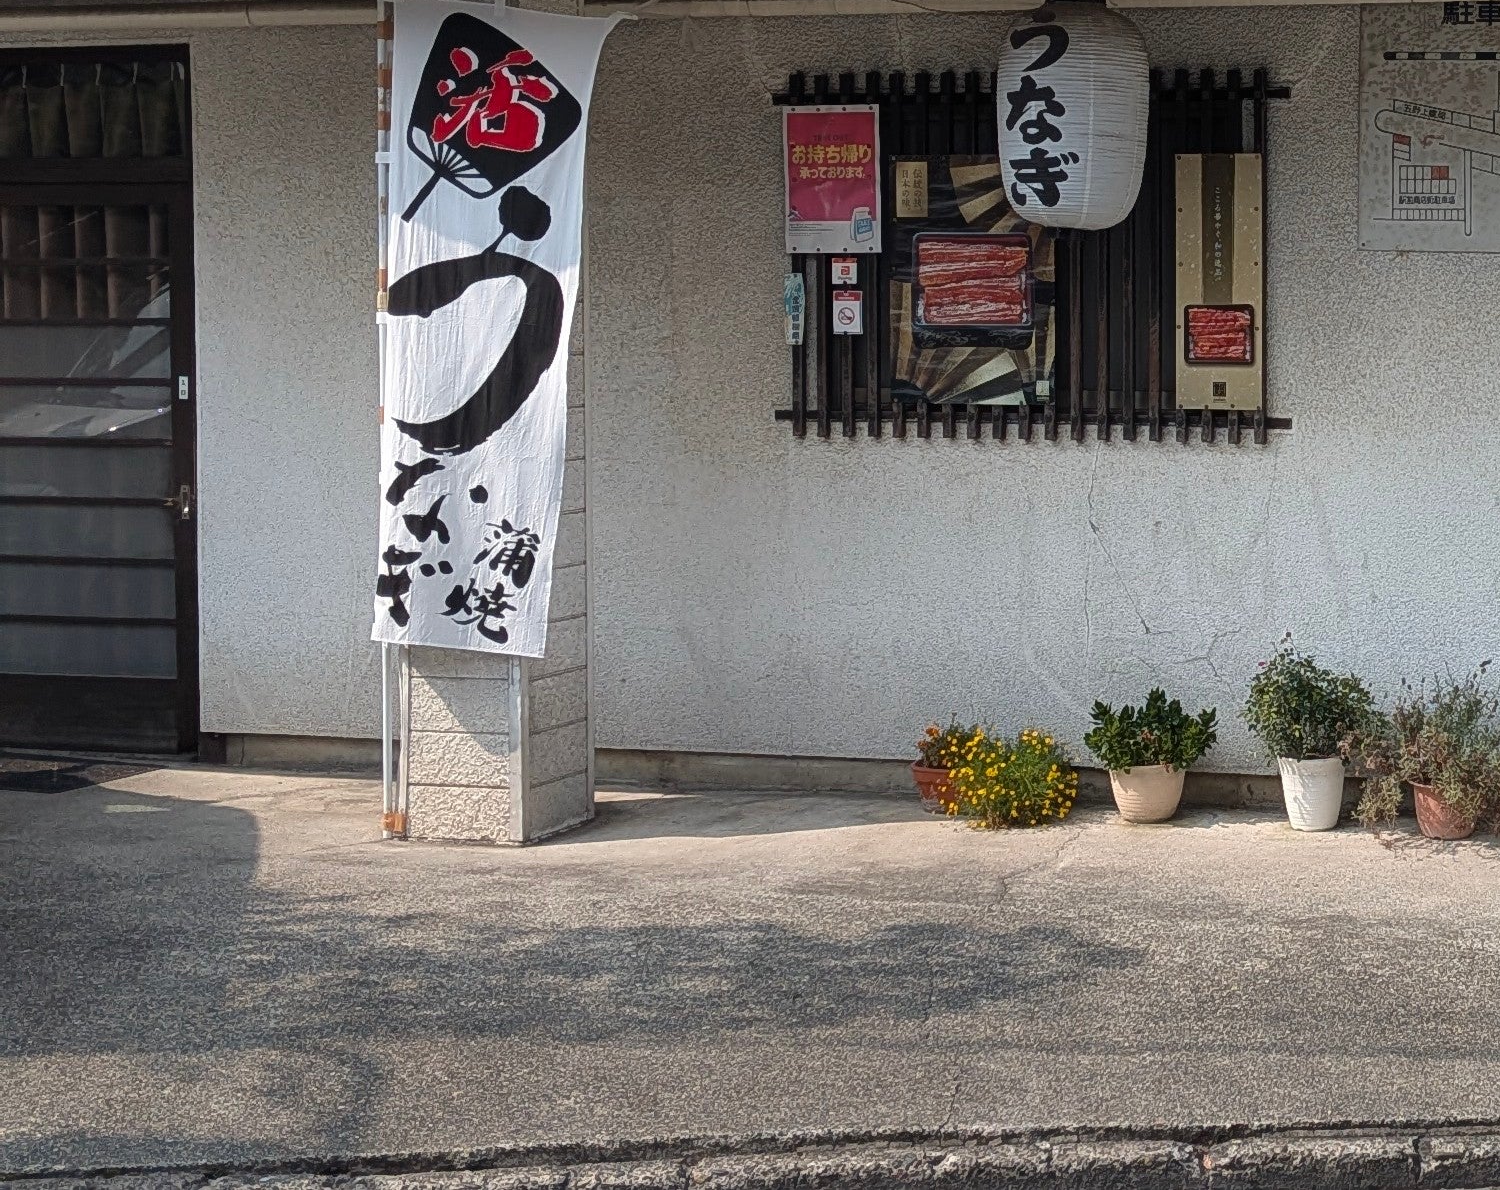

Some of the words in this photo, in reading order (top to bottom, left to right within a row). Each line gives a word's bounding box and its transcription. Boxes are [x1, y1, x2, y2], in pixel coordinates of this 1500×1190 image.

[431, 46, 558, 153] 活
[792, 143, 872, 164] お持ち帰り
[1005, 10, 1080, 207] うなぎ
[376, 185, 564, 628] うなぎ
[440, 518, 542, 643] 蒲焼
